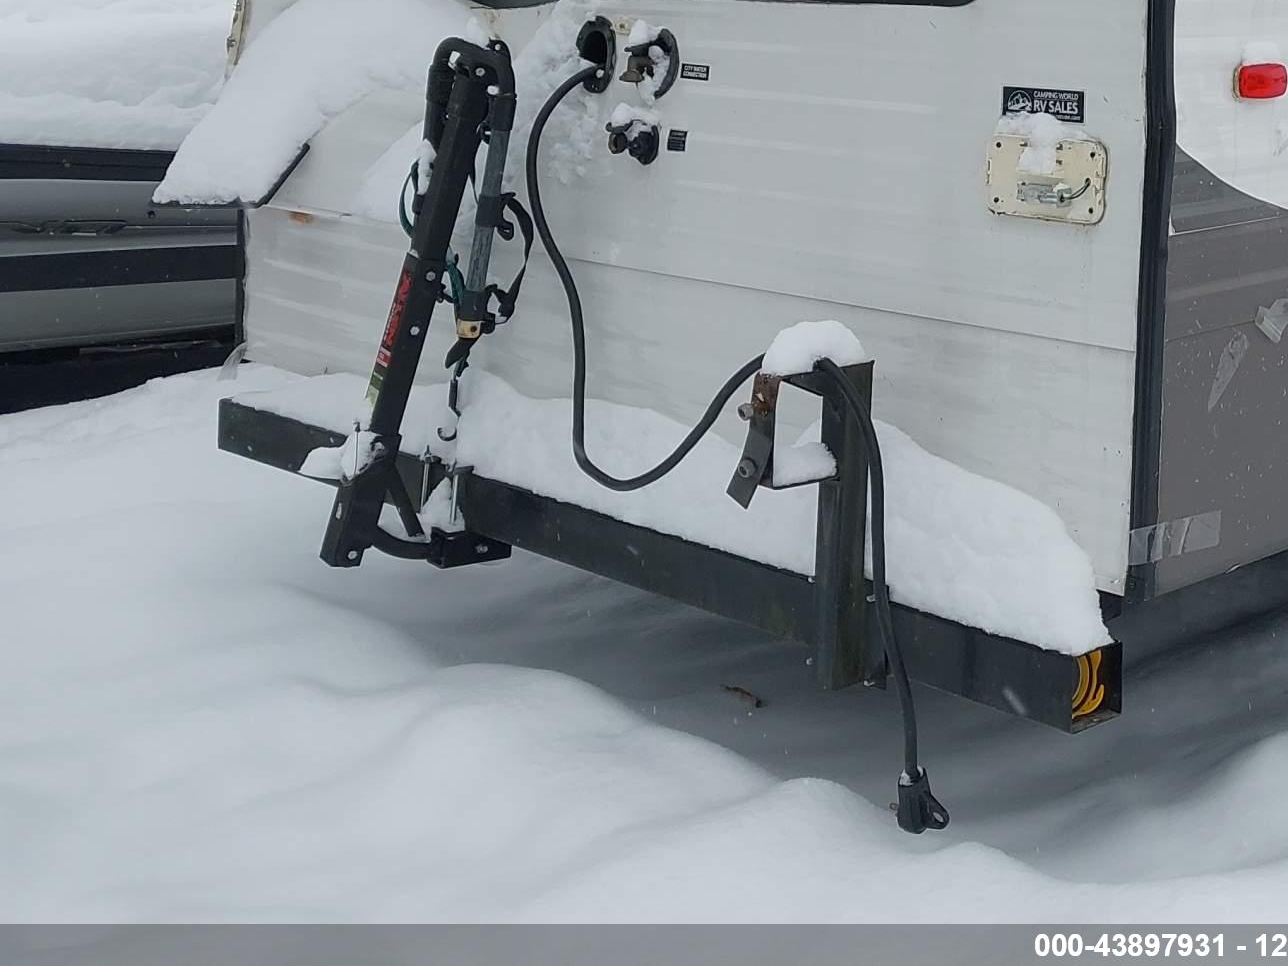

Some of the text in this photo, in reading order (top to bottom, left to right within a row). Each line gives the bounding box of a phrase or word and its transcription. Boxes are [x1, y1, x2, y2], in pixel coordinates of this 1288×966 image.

[1033, 90, 1079, 101] CAMPING WORLD
[1033, 99, 1079, 115] RV SALES
